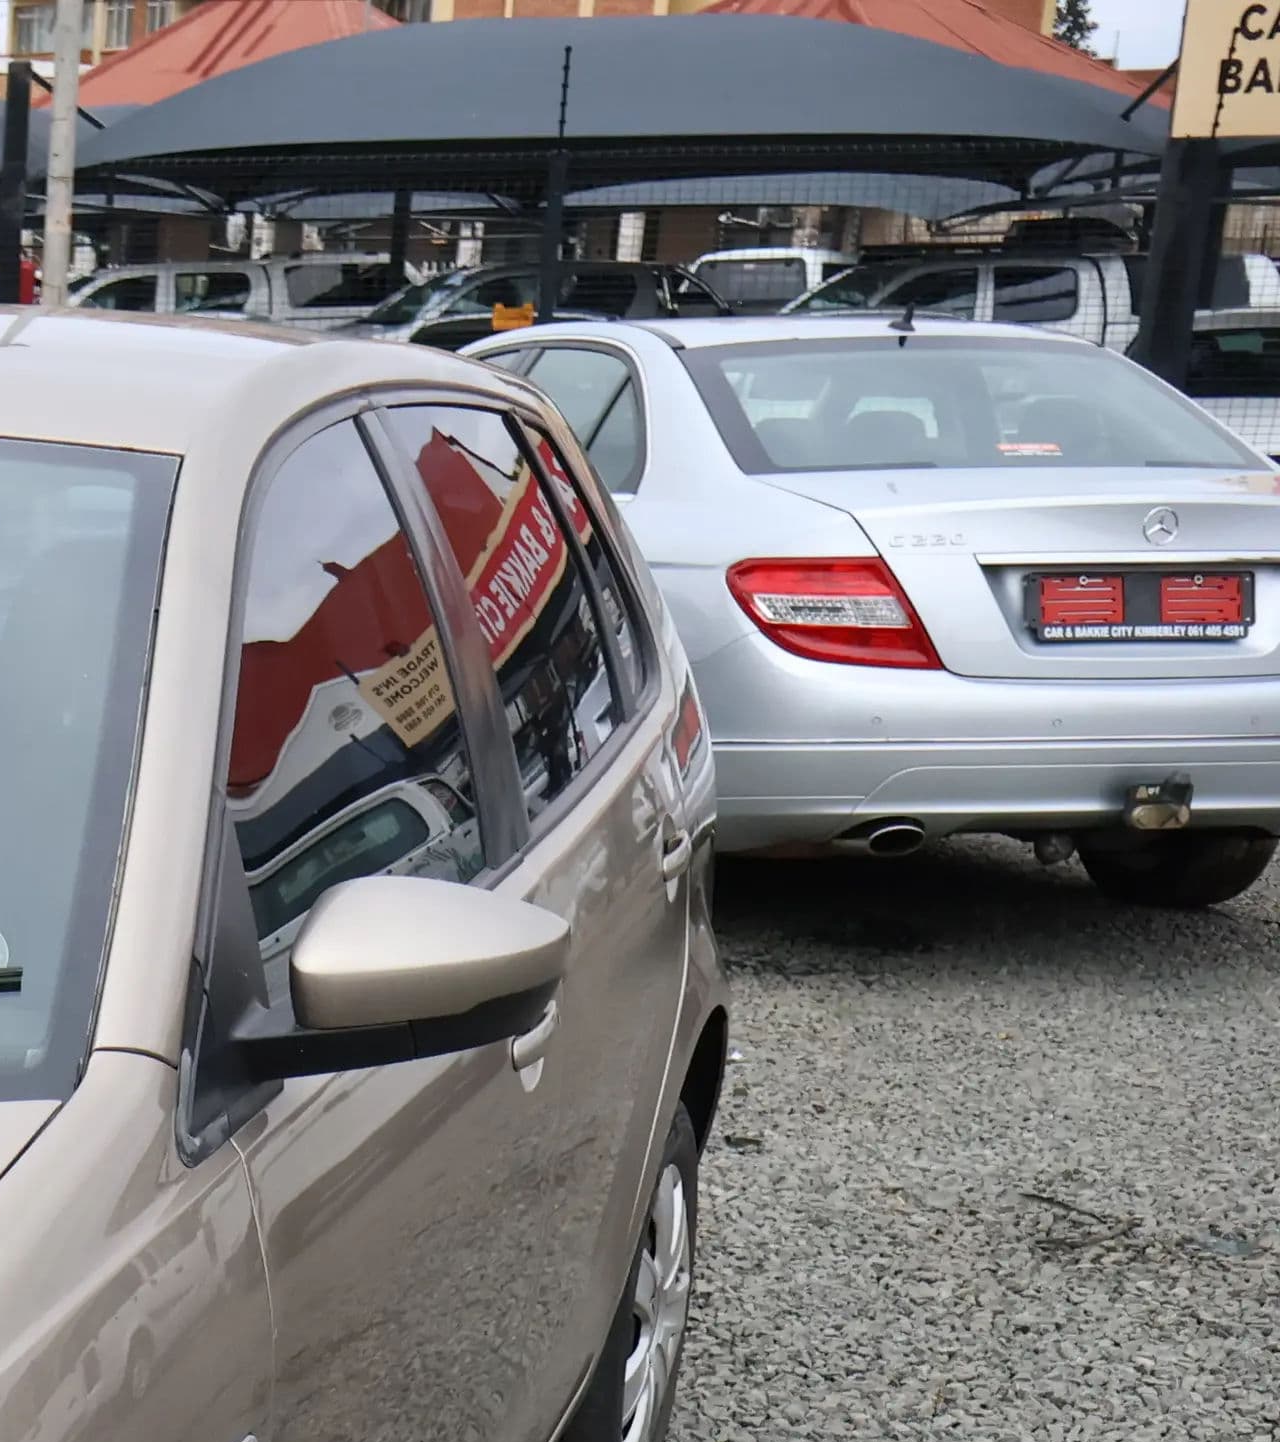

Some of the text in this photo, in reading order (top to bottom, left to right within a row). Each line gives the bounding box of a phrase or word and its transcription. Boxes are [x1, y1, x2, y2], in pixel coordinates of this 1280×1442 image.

[1217, 58, 1280, 95] BA
[1044, 627, 1064, 638] CAR
[1075, 627, 1110, 638] BAKKIE
[1111, 626, 1132, 637] CITY
